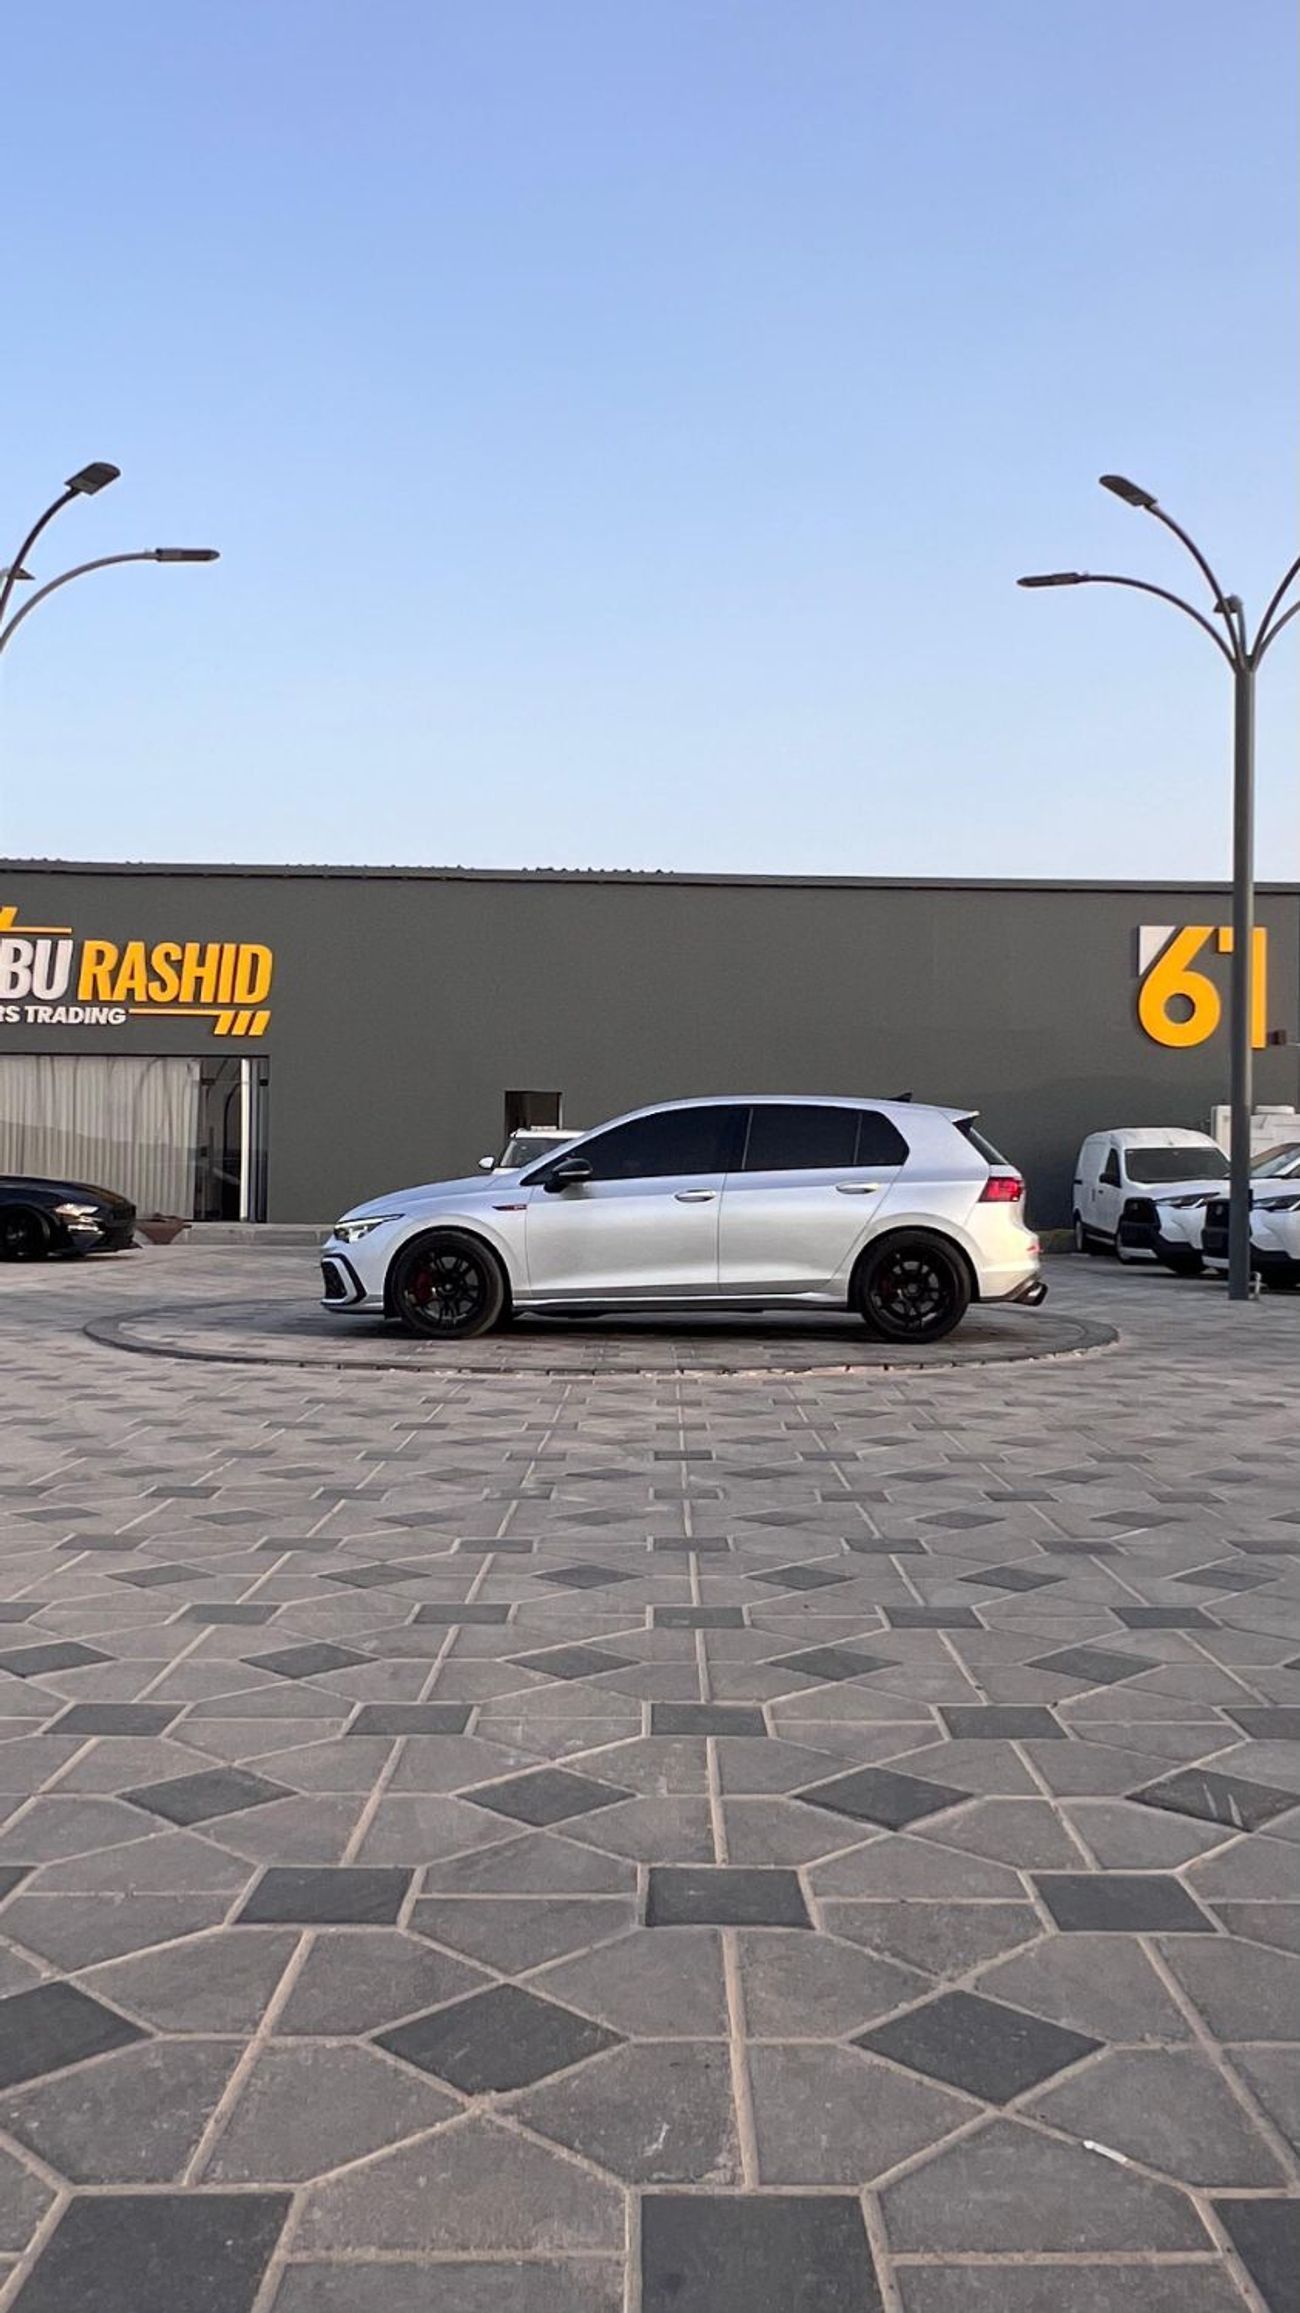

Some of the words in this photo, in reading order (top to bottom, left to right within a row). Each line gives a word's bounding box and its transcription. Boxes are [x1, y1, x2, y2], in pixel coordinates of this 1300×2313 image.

[0, 938, 73, 1000] BU
[77, 940, 272, 1003] RASHID
[1139, 925, 1267, 1048] 61
[24, 1005, 126, 1025] TRADING
